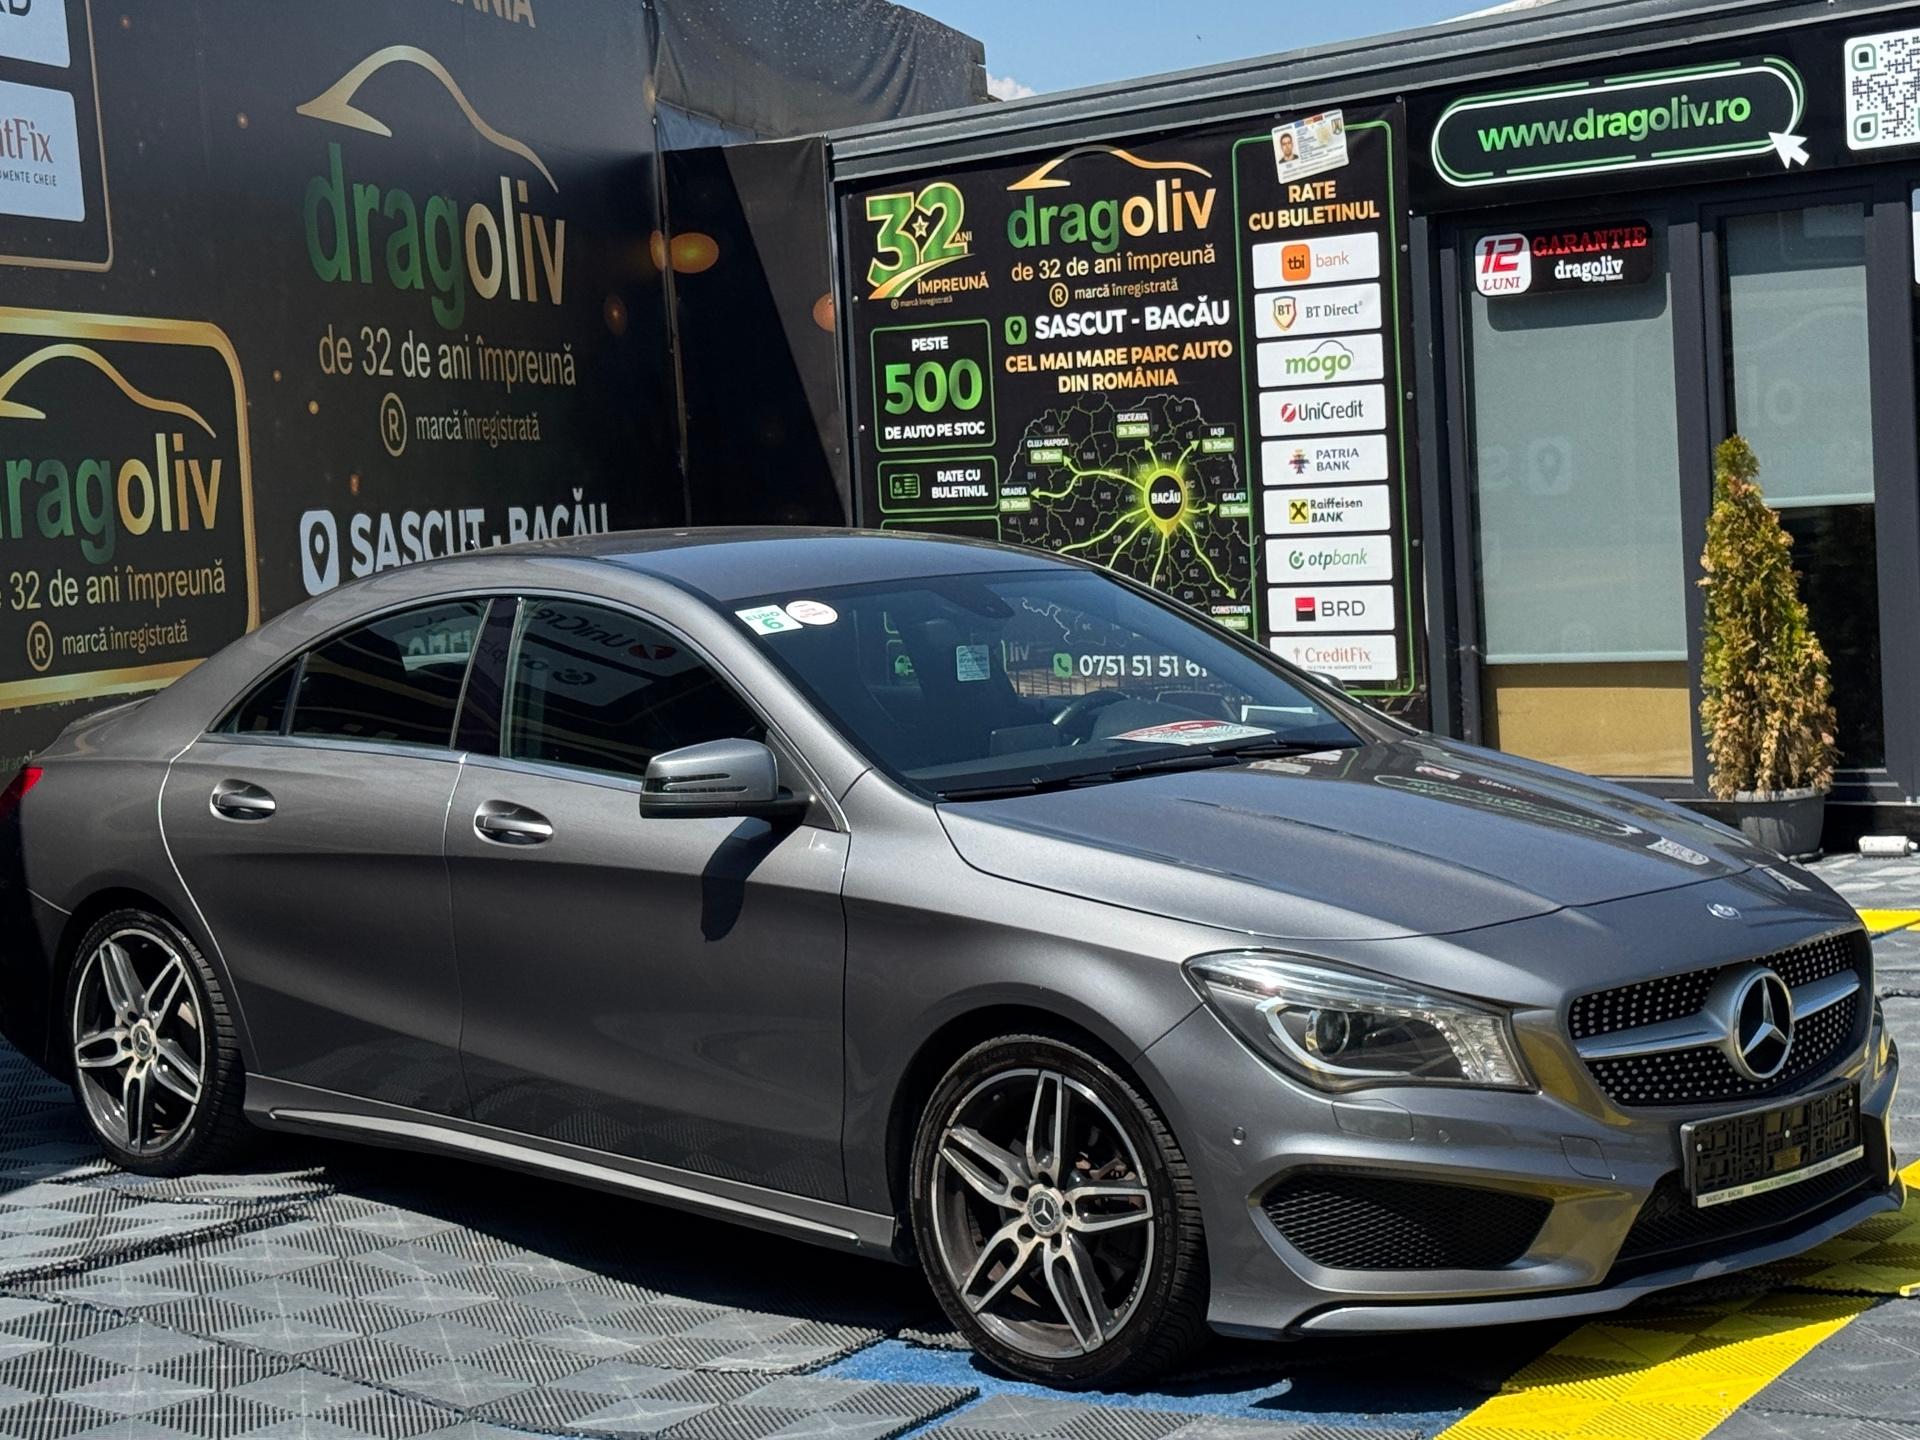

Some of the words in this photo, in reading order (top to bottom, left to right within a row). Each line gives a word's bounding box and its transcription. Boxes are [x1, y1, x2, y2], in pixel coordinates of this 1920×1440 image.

[1477, 94, 1750, 152] www.dragoliv.ro
[34, 173, 57, 187] CHEIE
[1288, 180, 1336, 204] RATE
[1007, 178, 1216, 254] dragoliv
[1248, 211, 1274, 231] CU
[1277, 200, 1380, 229] BULETINUL
[303, 142, 566, 331] dragoliv
[866, 182, 967, 287] 32
[954, 231, 973, 243] ANI
[1532, 226, 1647, 257] GARANTIE
[1011, 263, 1033, 281] de
[1039, 259, 1061, 279] 32
[1066, 256, 1089, 276] de
[1094, 253, 1121, 275] ani
[1127, 244, 1215, 274] împreună
[1287, 255, 1305, 270] tbi
[1316, 251, 1349, 268] bank
[1481, 237, 1524, 274] 12
[1554, 255, 1624, 283] dragoliv
[917, 271, 989, 295] ÎMPREUNĂ
[1075, 284, 1110, 300] marcă
[1112, 278, 1178, 299] înregistrată
[1483, 276, 1520, 291] LUNI
[1035, 309, 1127, 340] SASCUT
[1144, 295, 1230, 331] BACĂU
[1277, 305, 1291, 317] BT
[1306, 306, 1321, 318] BT
[911, 336, 949, 352] PESTE
[319, 324, 353, 376] de
[360, 326, 394, 377] 32
[401, 330, 431, 379] de
[439, 334, 473, 382] ani
[477, 335, 577, 394] împreună
[1005, 355, 1037, 373] CEL
[1040, 352, 1072, 371] MAI
[1077, 348, 1127, 369] MARE
[1131, 345, 1178, 365] PARC
[1182, 340, 1233, 362] AUTO
[1285, 352, 1352, 381] mogo
[884, 358, 983, 415] 500
[1058, 373, 1089, 393] DIN
[1092, 366, 1178, 392] ROMÂNIA
[1298, 400, 1364, 421] UniCredit
[416, 410, 462, 441] marcă
[462, 411, 541, 448] înregistrată
[885, 426, 901, 440] DE
[903, 424, 936, 439] AUTO
[937, 423, 953, 437] PE
[954, 421, 985, 436] STOC
[1316, 448, 1359, 460] PATRIA
[1316, 460, 1350, 472] BANK
[936, 470, 964, 483] RATE
[965, 469, 981, 481] CU
[0, 433, 222, 564] ragoliv
[931, 485, 988, 499] BULETINUL
[1151, 489, 1180, 505] BACĂU
[1310, 498, 1363, 510] Raiffeisen
[1311, 511, 1344, 523] BANK
[350, 507, 485, 578] SASCUT
[10, 570, 42, 611] 32
[49, 568, 79, 608] de
[86, 566, 120, 605] ani
[125, 559, 226, 608] împreună
[1321, 600, 1366, 617] BRD
[762, 618, 784, 629] 6
[62, 626, 108, 656] marcă
[110, 619, 189, 655] înregistrată
[1079, 654, 1125, 677] 0751
[1131, 654, 1152, 677] 51
[1158, 654, 1179, 677] 51
[1305, 647, 1372, 664] CreditFix
